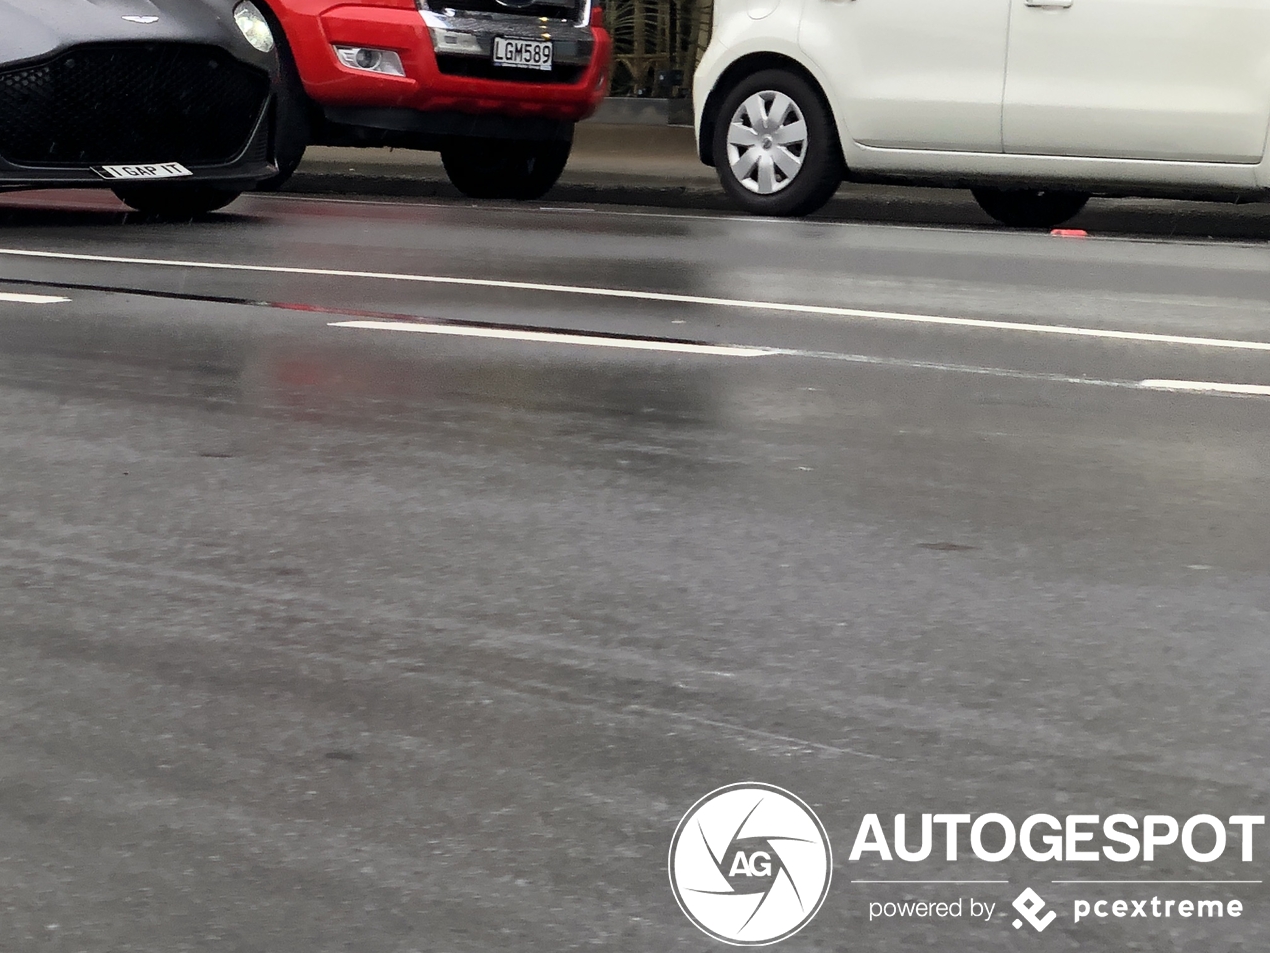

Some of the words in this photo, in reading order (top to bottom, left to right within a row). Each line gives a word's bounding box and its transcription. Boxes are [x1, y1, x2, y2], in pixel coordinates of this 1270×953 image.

[494, 40, 551, 64] LGM589
[122, 166, 157, 177] GAP
[160, 164, 183, 174] IT
